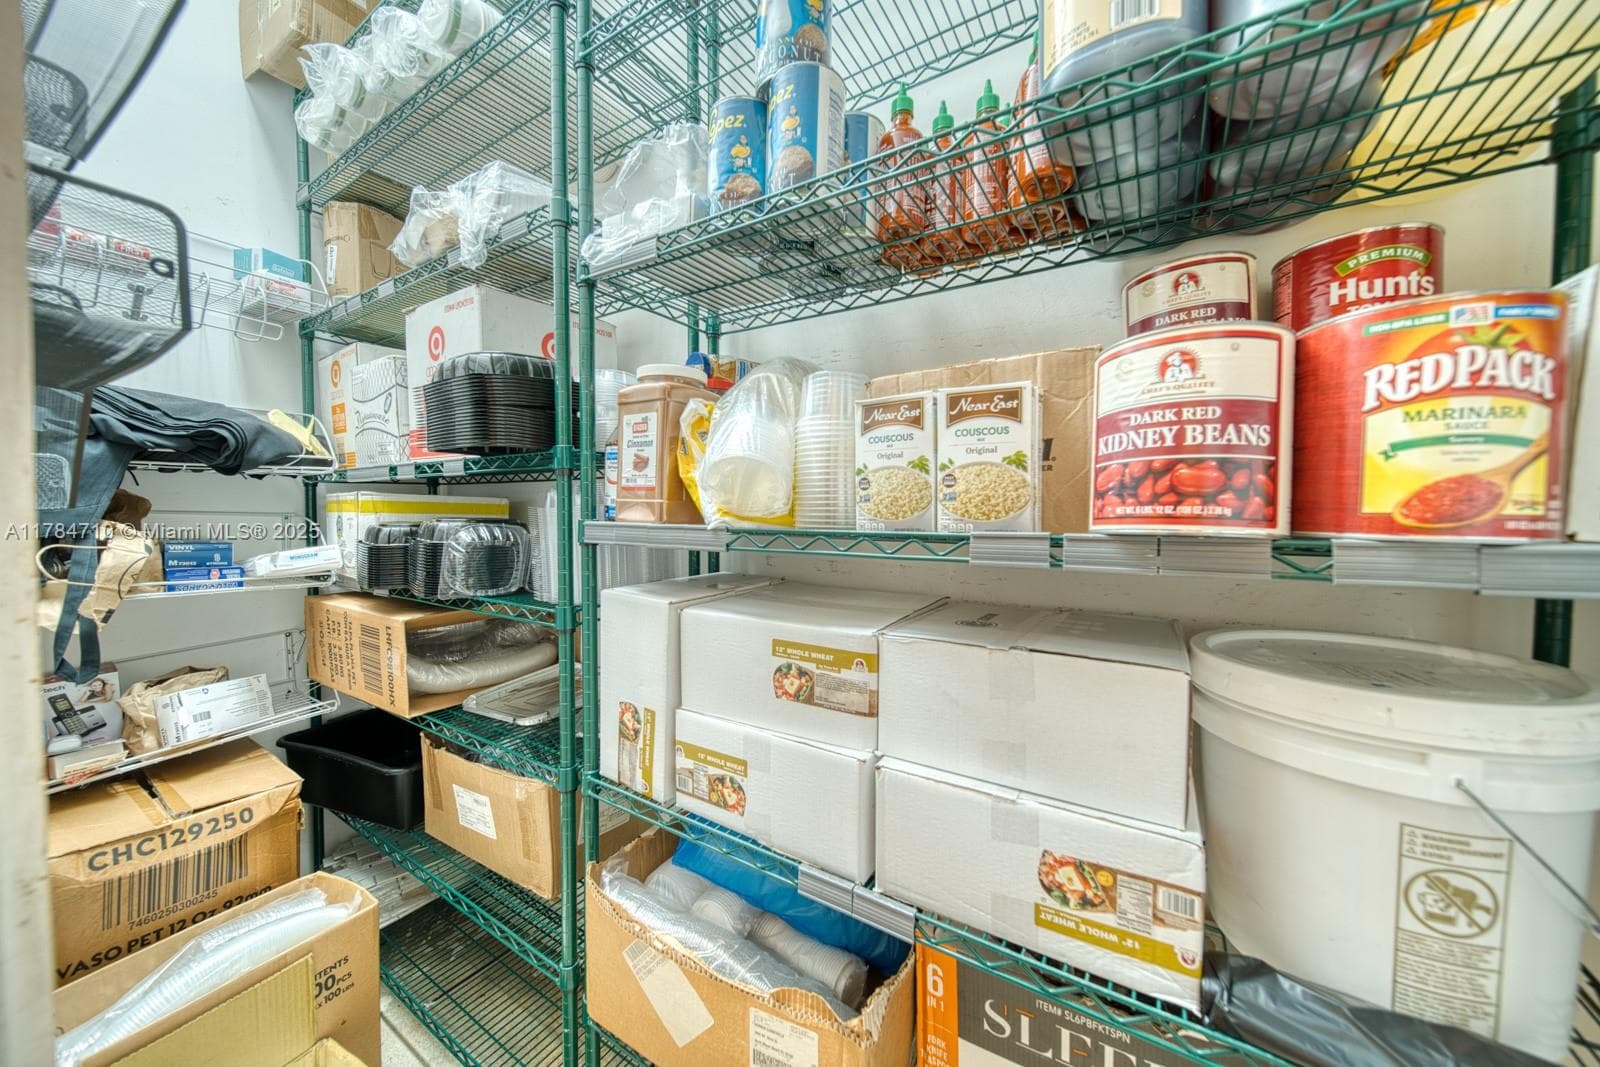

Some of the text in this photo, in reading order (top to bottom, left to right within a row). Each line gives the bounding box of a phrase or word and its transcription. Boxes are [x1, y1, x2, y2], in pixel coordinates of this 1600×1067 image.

[1347, 247, 1424, 269] PREMIUM
[1155, 311, 1189, 327] DARK
[1190, 306, 1216, 319] RED
[864, 404, 921, 423] Near East
[950, 394, 1019, 415] Near East
[1402, 405, 1527, 423] MARINARA
[1129, 405, 1223, 427] DARK RED
[867, 432, 915, 445] COUSCOUS
[954, 425, 1010, 438] COUSCOUS
[1097, 423, 1271, 456] KIDNEY BEANS
[876, 451, 905, 462] Original
[965, 445, 999, 457] Original
[786, 648, 810, 657] WHOLE
[811, 653, 834, 662] WHEAT
[87, 806, 255, 873] CHC129250
[1039, 911, 1077, 930] WHEAT
[1078, 923, 1119, 944] WHOLE
[56, 946, 123, 980] VASO
[126, 926, 166, 954] PET
[167, 918, 188, 940] 12
[926, 963, 945, 998] 6
[324, 987, 341, 1004] 100
[927, 996, 945, 1012] IN 1
